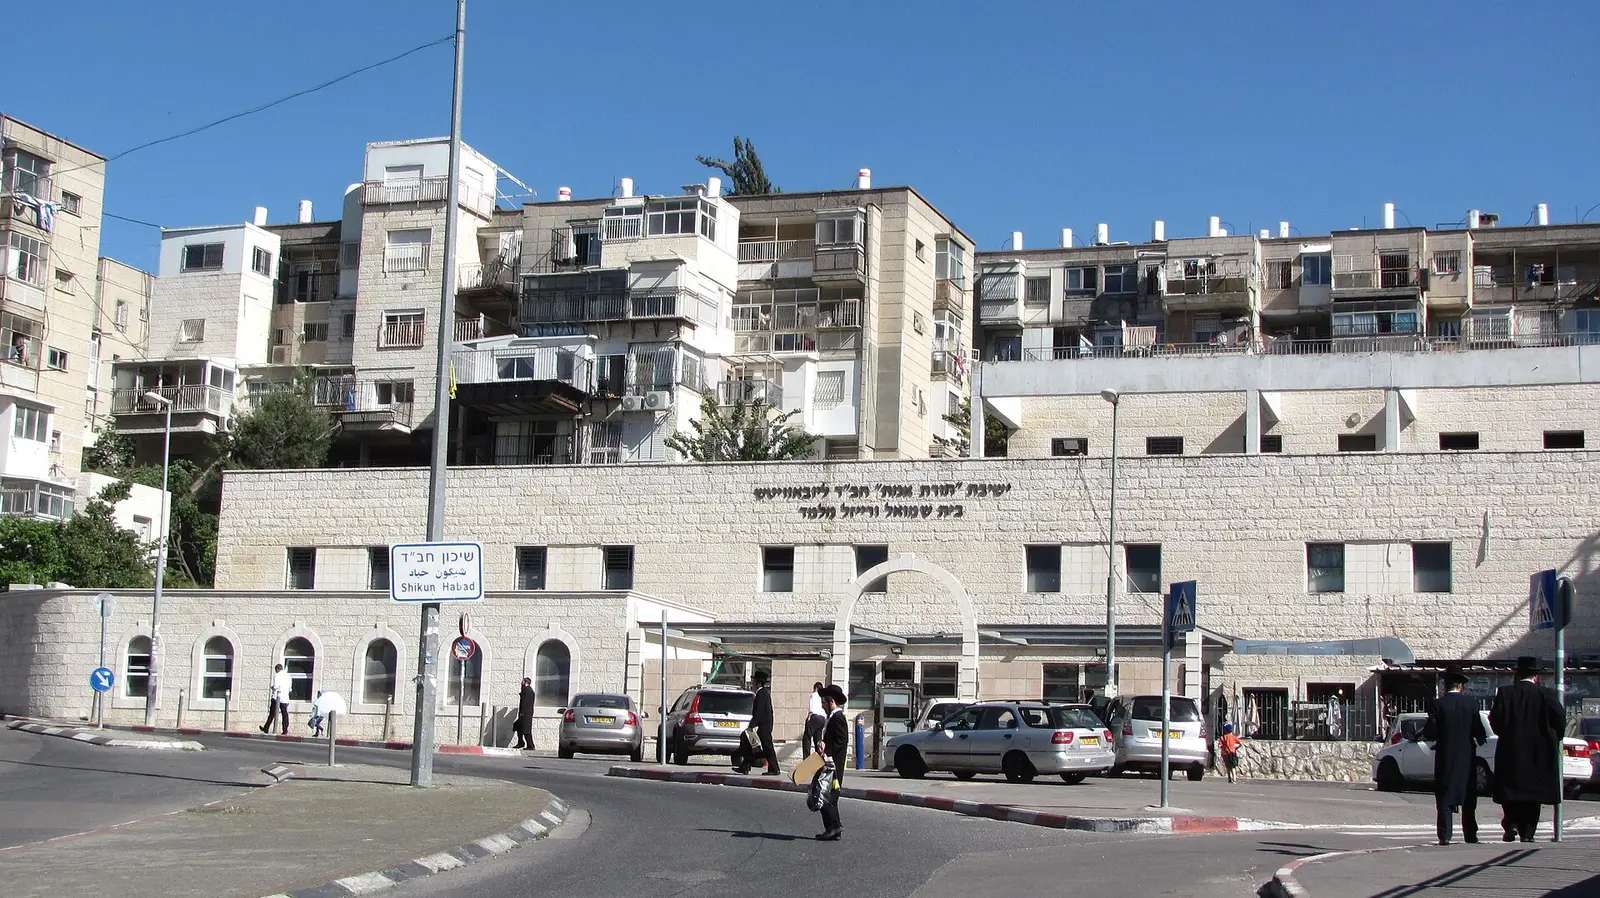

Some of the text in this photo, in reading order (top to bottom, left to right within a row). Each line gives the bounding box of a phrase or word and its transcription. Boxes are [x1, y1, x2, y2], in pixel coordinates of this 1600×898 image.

[834, 483, 870, 498] חב"ד
[966, 482, 1012, 498] ישיבת
[797, 503, 836, 519] מלמד
[884, 502, 933, 519] שמואל
[936, 504, 964, 518] בית
[401, 551, 474, 565] שיכון חב"ד
[409, 567, 467, 579] شيكون حباد
[401, 581, 475, 592] Shikun Habad
